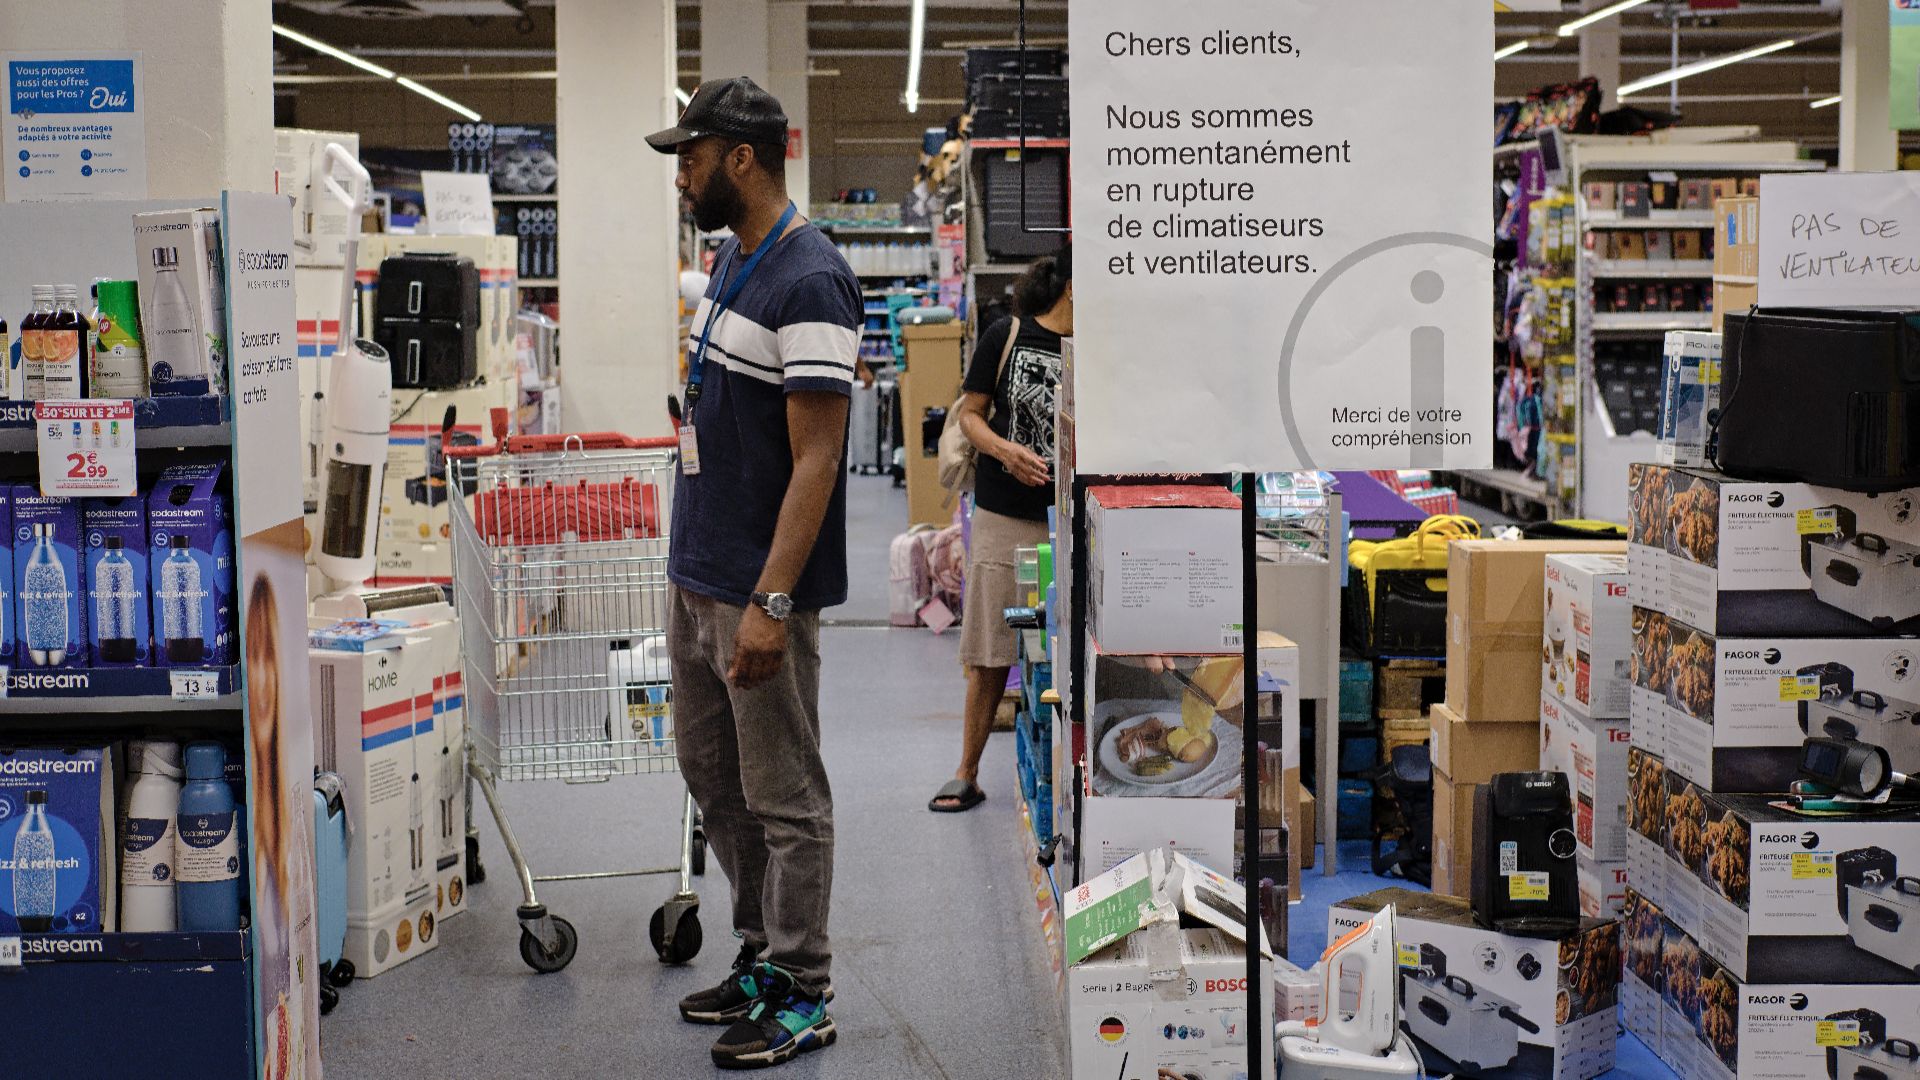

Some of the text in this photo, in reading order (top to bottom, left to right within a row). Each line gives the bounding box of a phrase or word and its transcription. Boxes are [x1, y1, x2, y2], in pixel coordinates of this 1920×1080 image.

[1105, 30, 1301, 58] Chers clients,
[16, 66, 85, 77] Vous proposez
[16, 77, 89, 87] aussi des offres
[17, 89, 84, 100] pour les Pros ?
[89, 86, 127, 109] Oui
[1106, 105, 1313, 129] Nous sommes
[30, 125, 70, 133] nombreux
[72, 125, 113, 134] avantages
[18, 134, 49, 142] adaptés
[81, 132, 112, 140] activité
[1107, 140, 1351, 166] momentanément
[1107, 178, 1254, 207] en rupture
[1107, 213, 1324, 238] de climatiseurs
[1791, 213, 1900, 240] PAS DE
[1108, 249, 1318, 275] et ventilateurs.
[63, 407, 87, 418] SUR
[91, 406, 104, 418] LE
[1332, 407, 1462, 423] Merci de votre
[1332, 429, 1472, 449] compréhension
[66, 453, 108, 478] 2 € 99
[16, 496, 70, 504] sodastream
[1728, 494, 1763, 502] FAGOR
[86, 509, 137, 518] sodastream
[151, 508, 204, 518] sodastream
[1546, 564, 1560, 583] Tefal
[20, 590, 72, 599] fizz & refresh
[113, 591, 141, 599] refresh
[1603, 582, 1627, 597] Te
[1724, 651, 1760, 659] FAGOR
[184, 681, 200, 693] 13
[1542, 702, 1559, 721] Tefal
[1606, 728, 1631, 742] Te
[0, 758, 95, 774] dastream
[1760, 834, 1797, 843] FAGOR
[20, 858, 28, 869] &
[31, 856, 79, 870] refresh
[75, 912, 86, 921] x2
[1083, 984, 1107, 993] Serie
[1115, 983, 1122, 992] 2
[1748, 995, 1785, 1004] FAGOR
